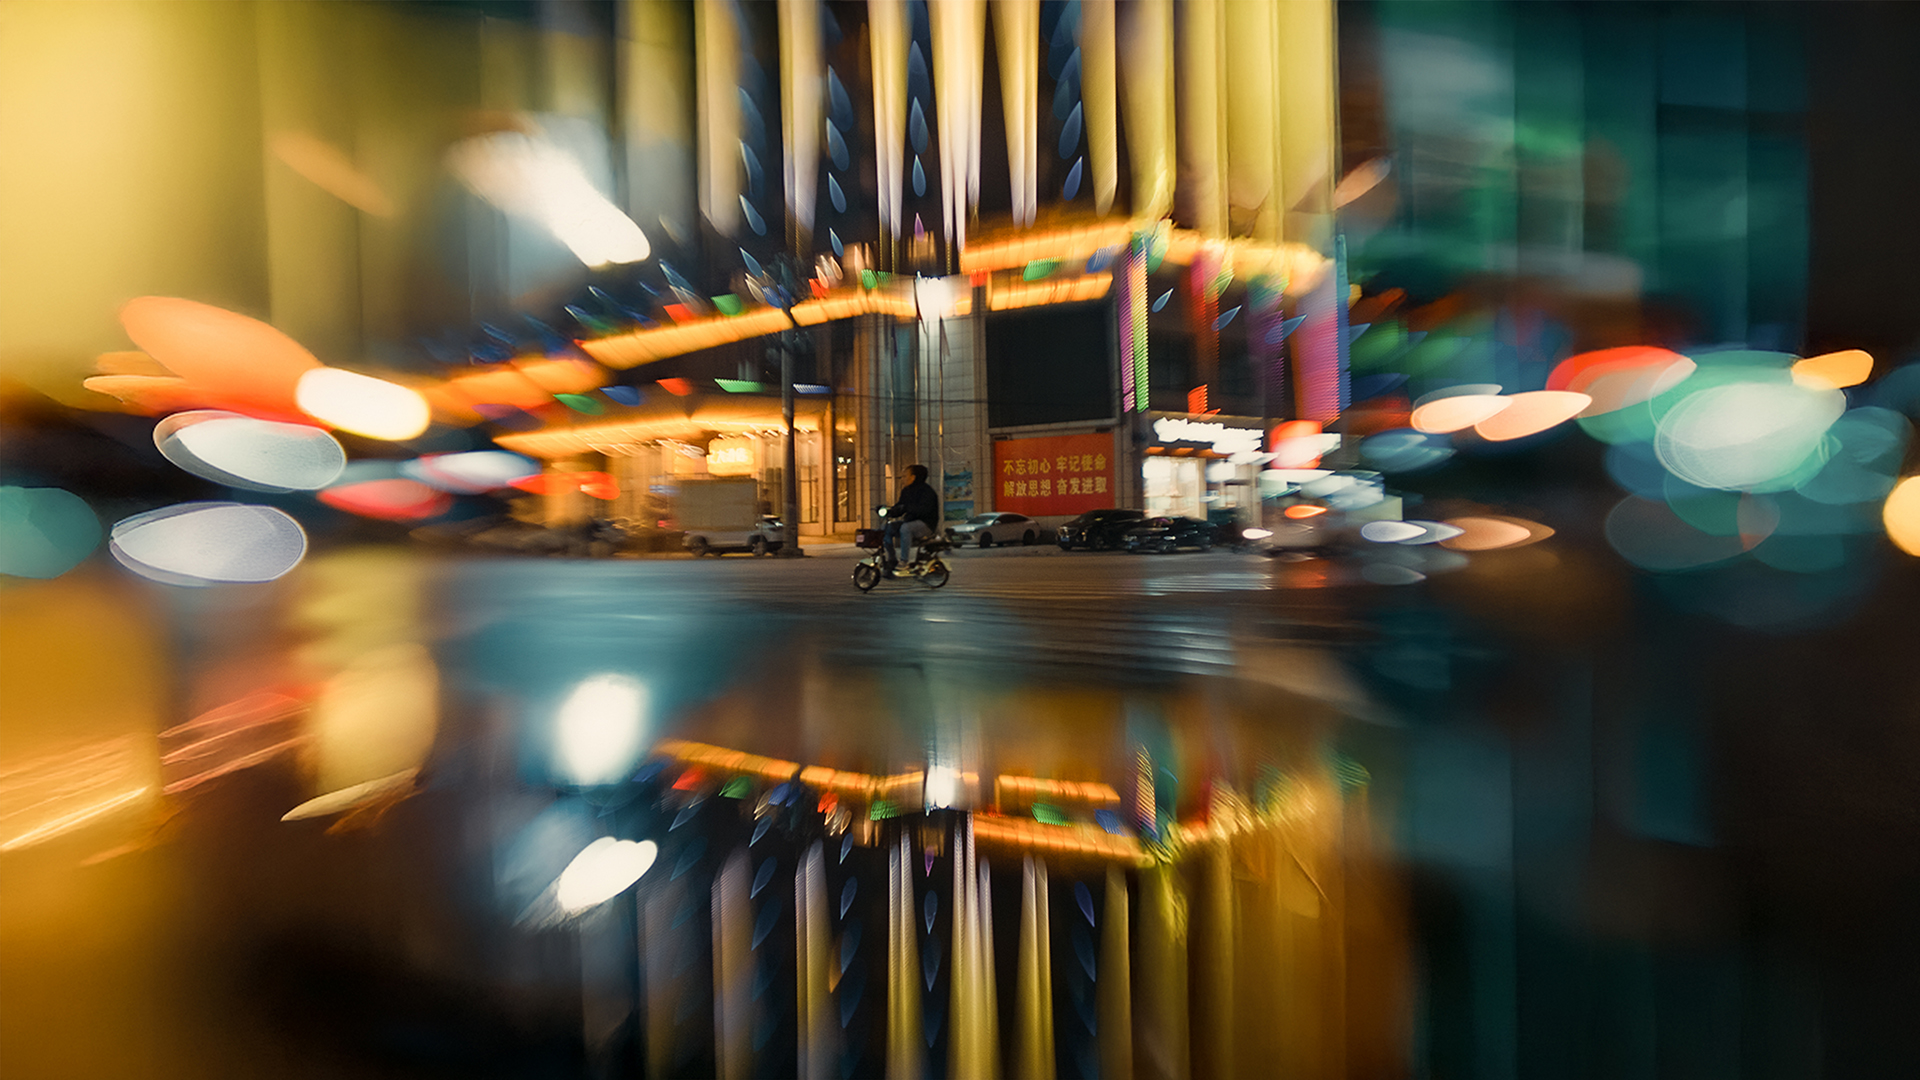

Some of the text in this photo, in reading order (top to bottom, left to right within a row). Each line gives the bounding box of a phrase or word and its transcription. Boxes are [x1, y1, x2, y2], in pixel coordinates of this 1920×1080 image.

[1003, 454, 1106, 475] 不忘初心 牢记使命
[1003, 476, 1107, 497] 解放思想 奋发进取
